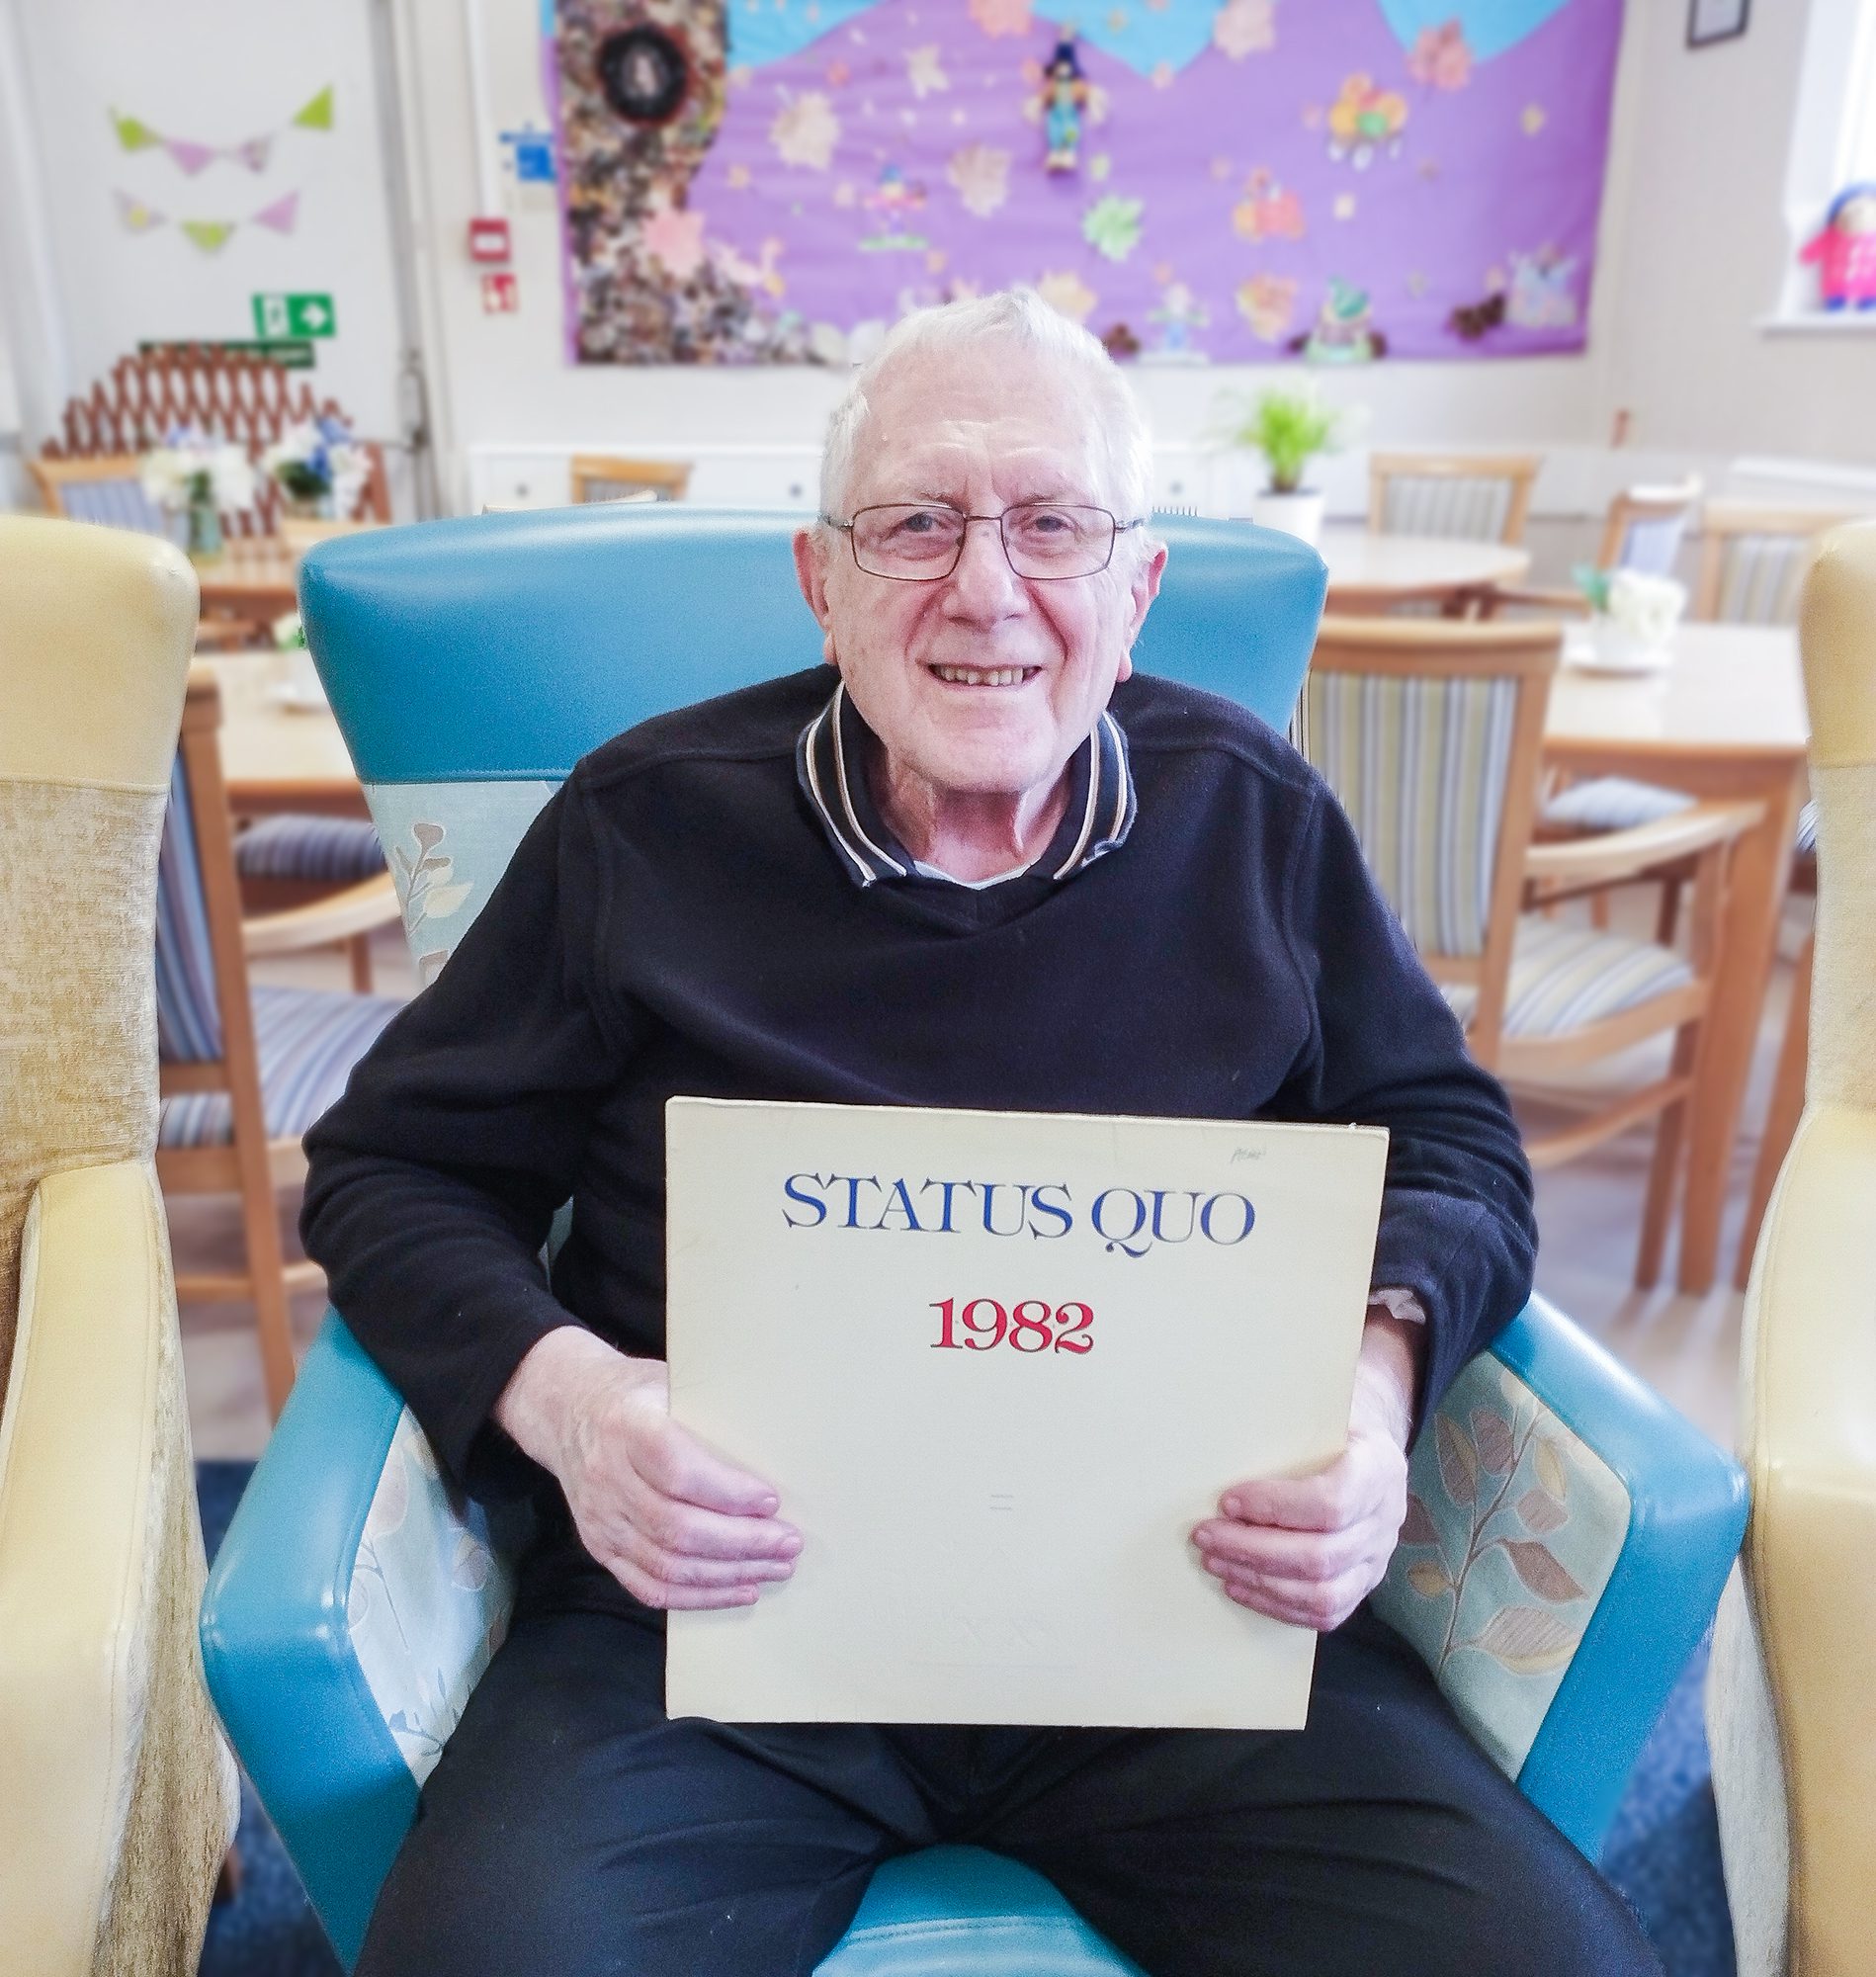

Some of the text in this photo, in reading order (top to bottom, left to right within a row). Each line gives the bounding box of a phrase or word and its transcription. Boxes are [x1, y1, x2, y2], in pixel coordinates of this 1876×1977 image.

[783, 1172, 1256, 1258] STATUS QUO
[929, 1297, 1094, 1354] 1982
